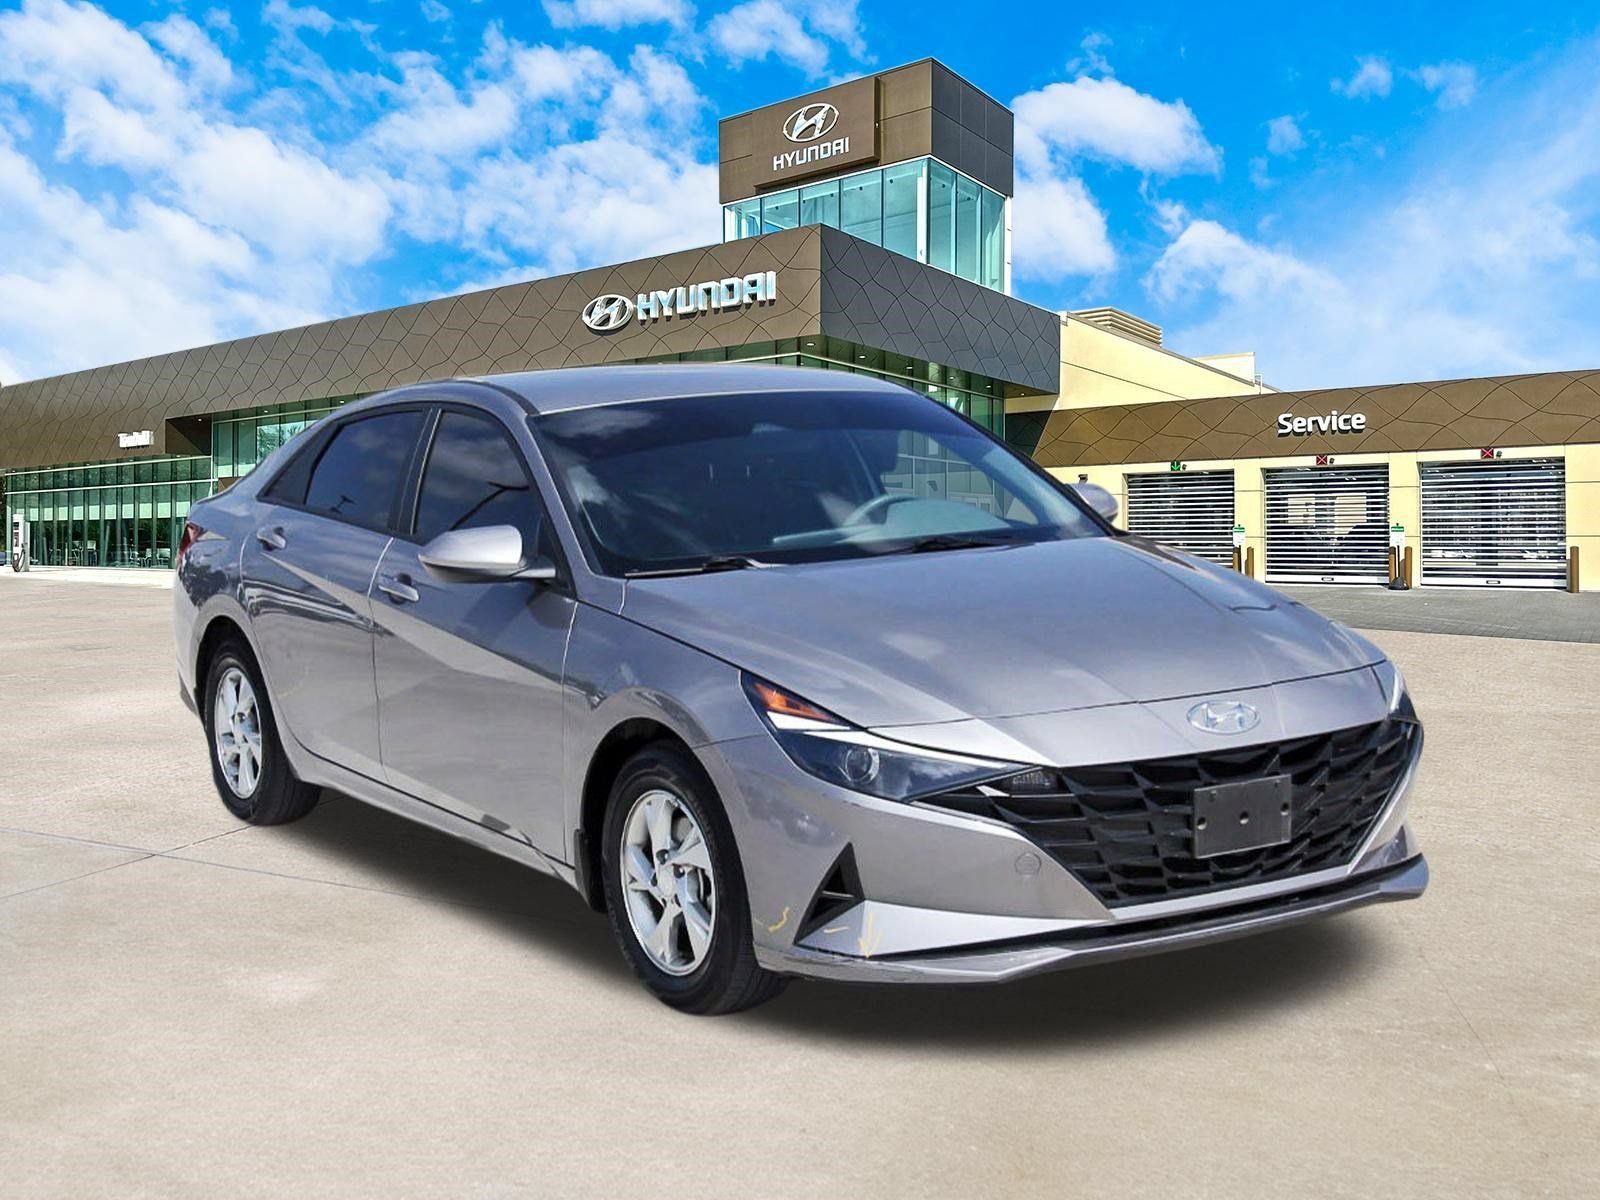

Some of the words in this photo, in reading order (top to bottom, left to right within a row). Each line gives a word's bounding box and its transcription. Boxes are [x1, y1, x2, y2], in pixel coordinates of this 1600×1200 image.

[773, 137, 849, 171] HYUNDAI
[636, 270, 777, 321] HYUNDAI
[1278, 410, 1366, 434] Service
